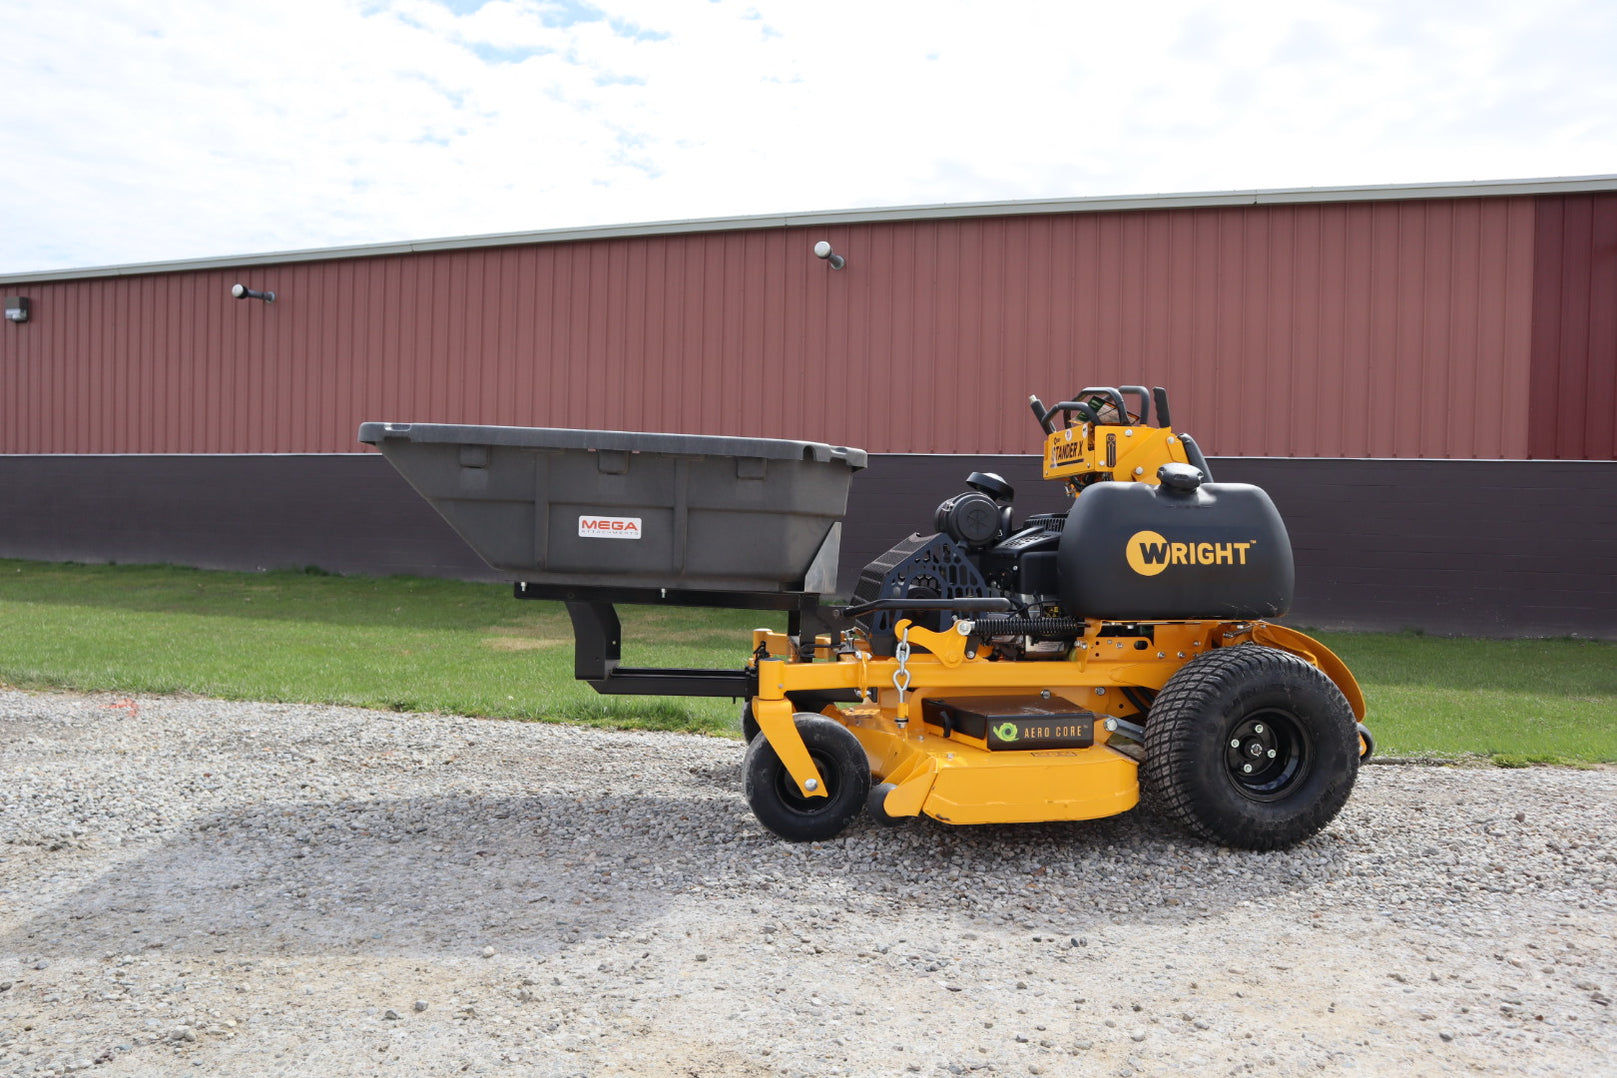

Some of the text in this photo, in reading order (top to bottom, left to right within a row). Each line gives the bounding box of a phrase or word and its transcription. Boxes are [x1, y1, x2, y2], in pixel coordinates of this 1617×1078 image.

[582, 520, 638, 531] MEGA
[1139, 542, 1251, 565] WRIGHT
[1024, 725, 1082, 739] AERO CORE
